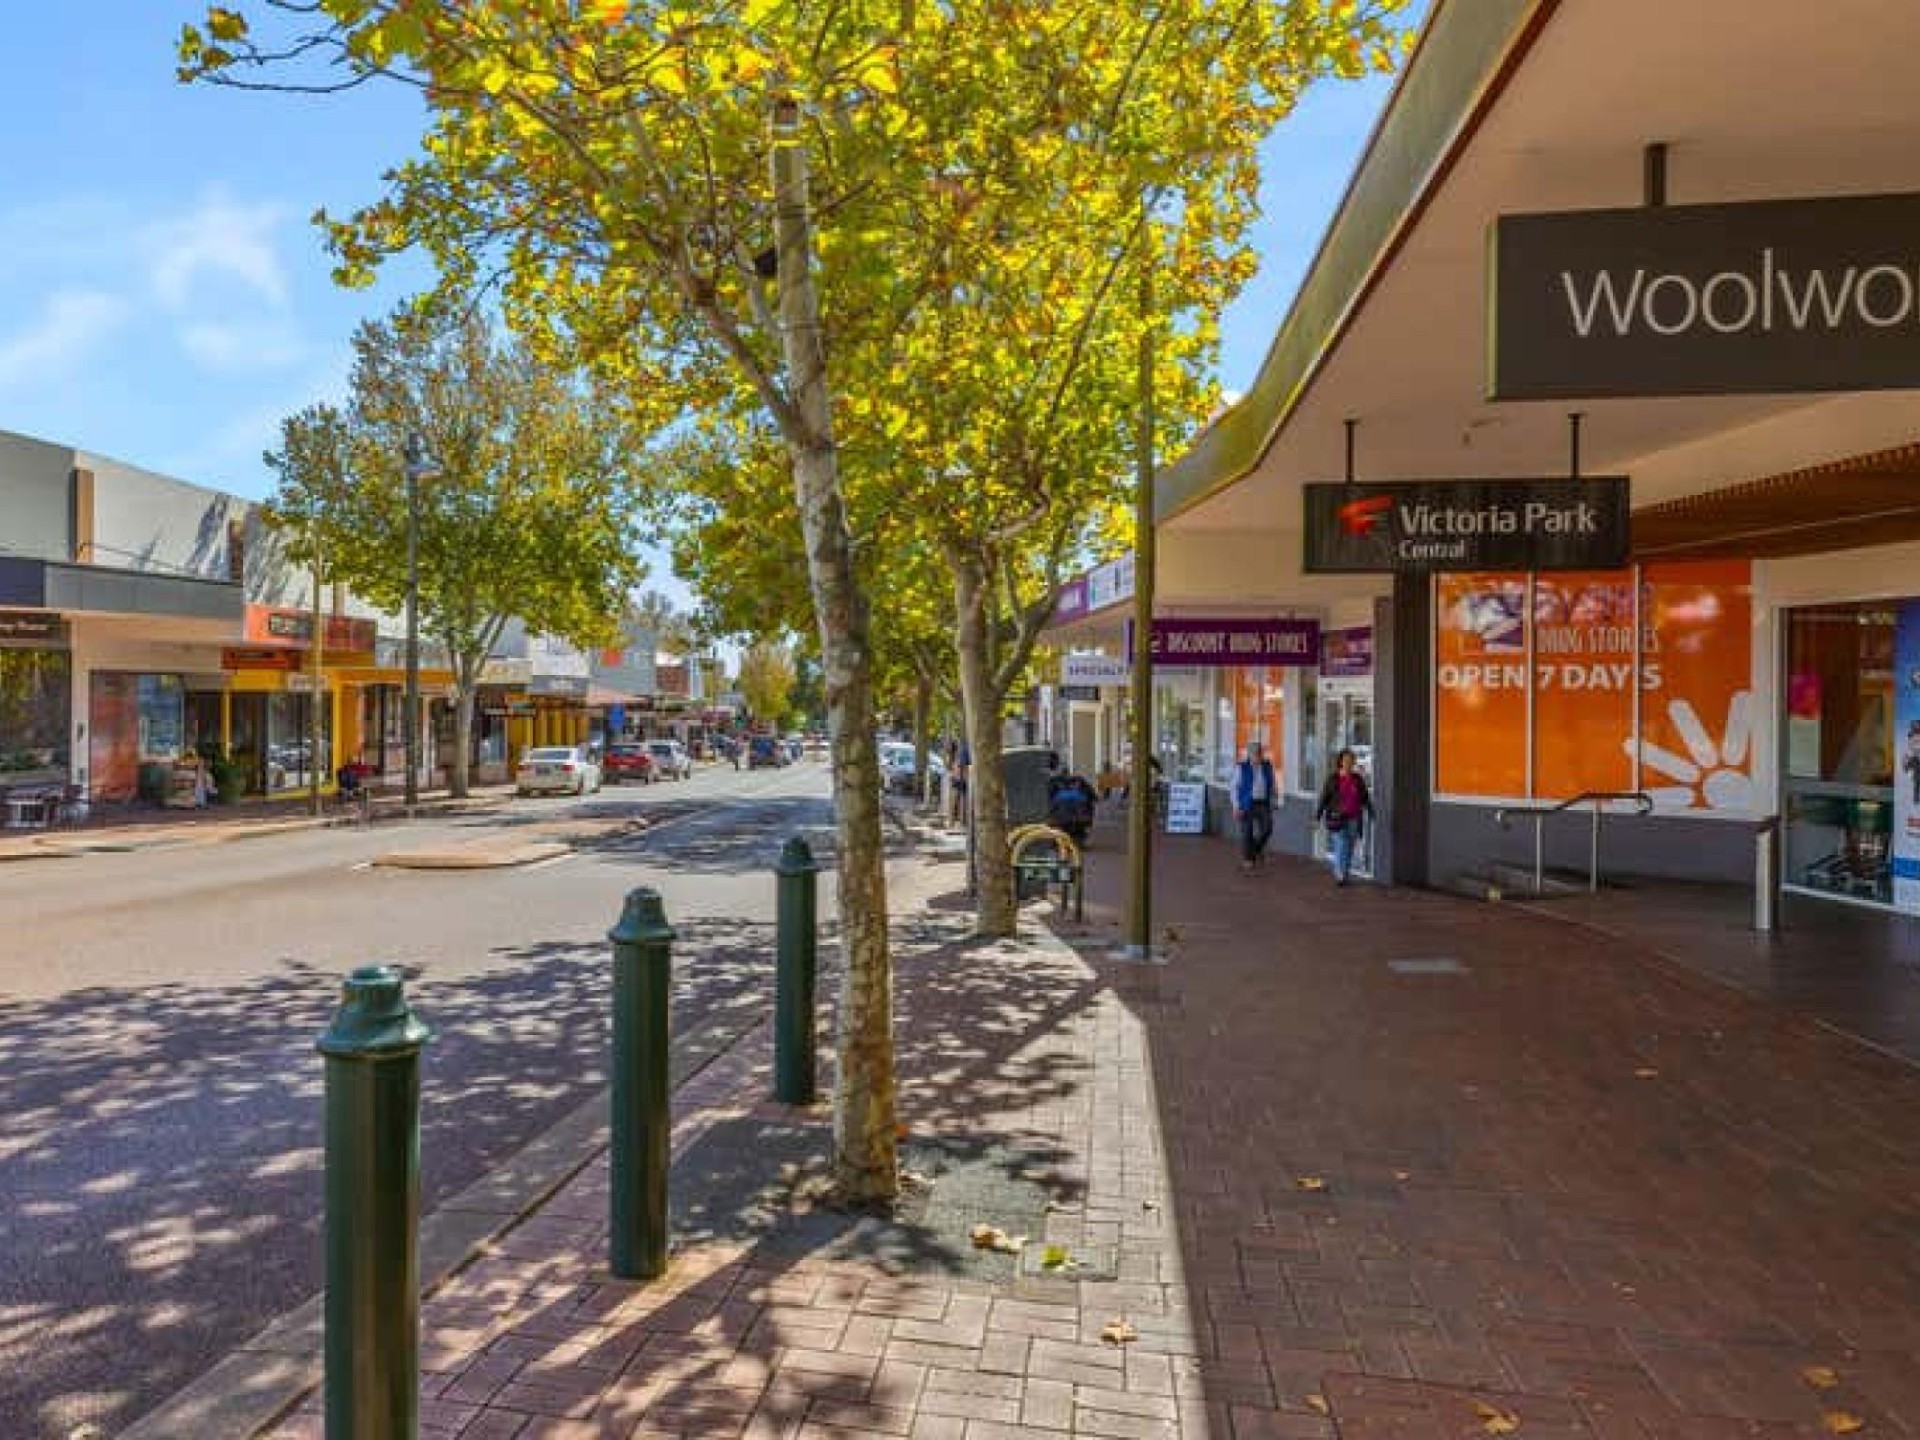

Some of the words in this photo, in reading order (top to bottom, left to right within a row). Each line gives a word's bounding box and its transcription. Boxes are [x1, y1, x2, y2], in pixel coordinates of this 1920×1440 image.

[1400, 504, 1518, 534] Victoria
[1524, 502, 1596, 533] Park
[1400, 539, 1465, 558] Central
[1438, 664, 1524, 690] OPEN
[1537, 664, 1555, 690] 7
